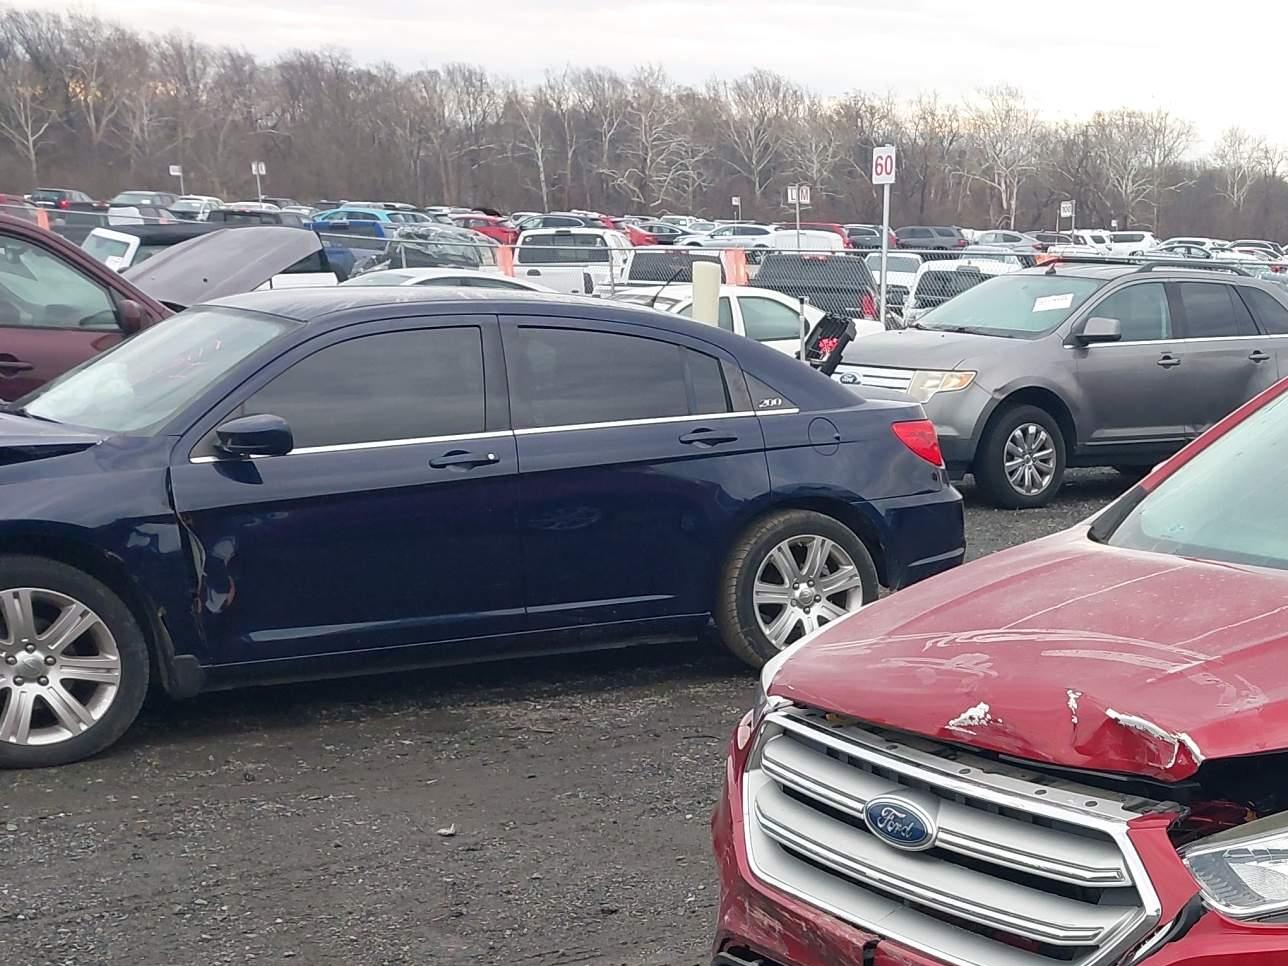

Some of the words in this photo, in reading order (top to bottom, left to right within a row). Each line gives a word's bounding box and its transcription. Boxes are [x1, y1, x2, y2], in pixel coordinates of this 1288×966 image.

[874, 155, 894, 176] 60
[800, 187, 809, 200] M
[759, 398, 782, 408] 200
[877, 806, 915, 838] Ford
